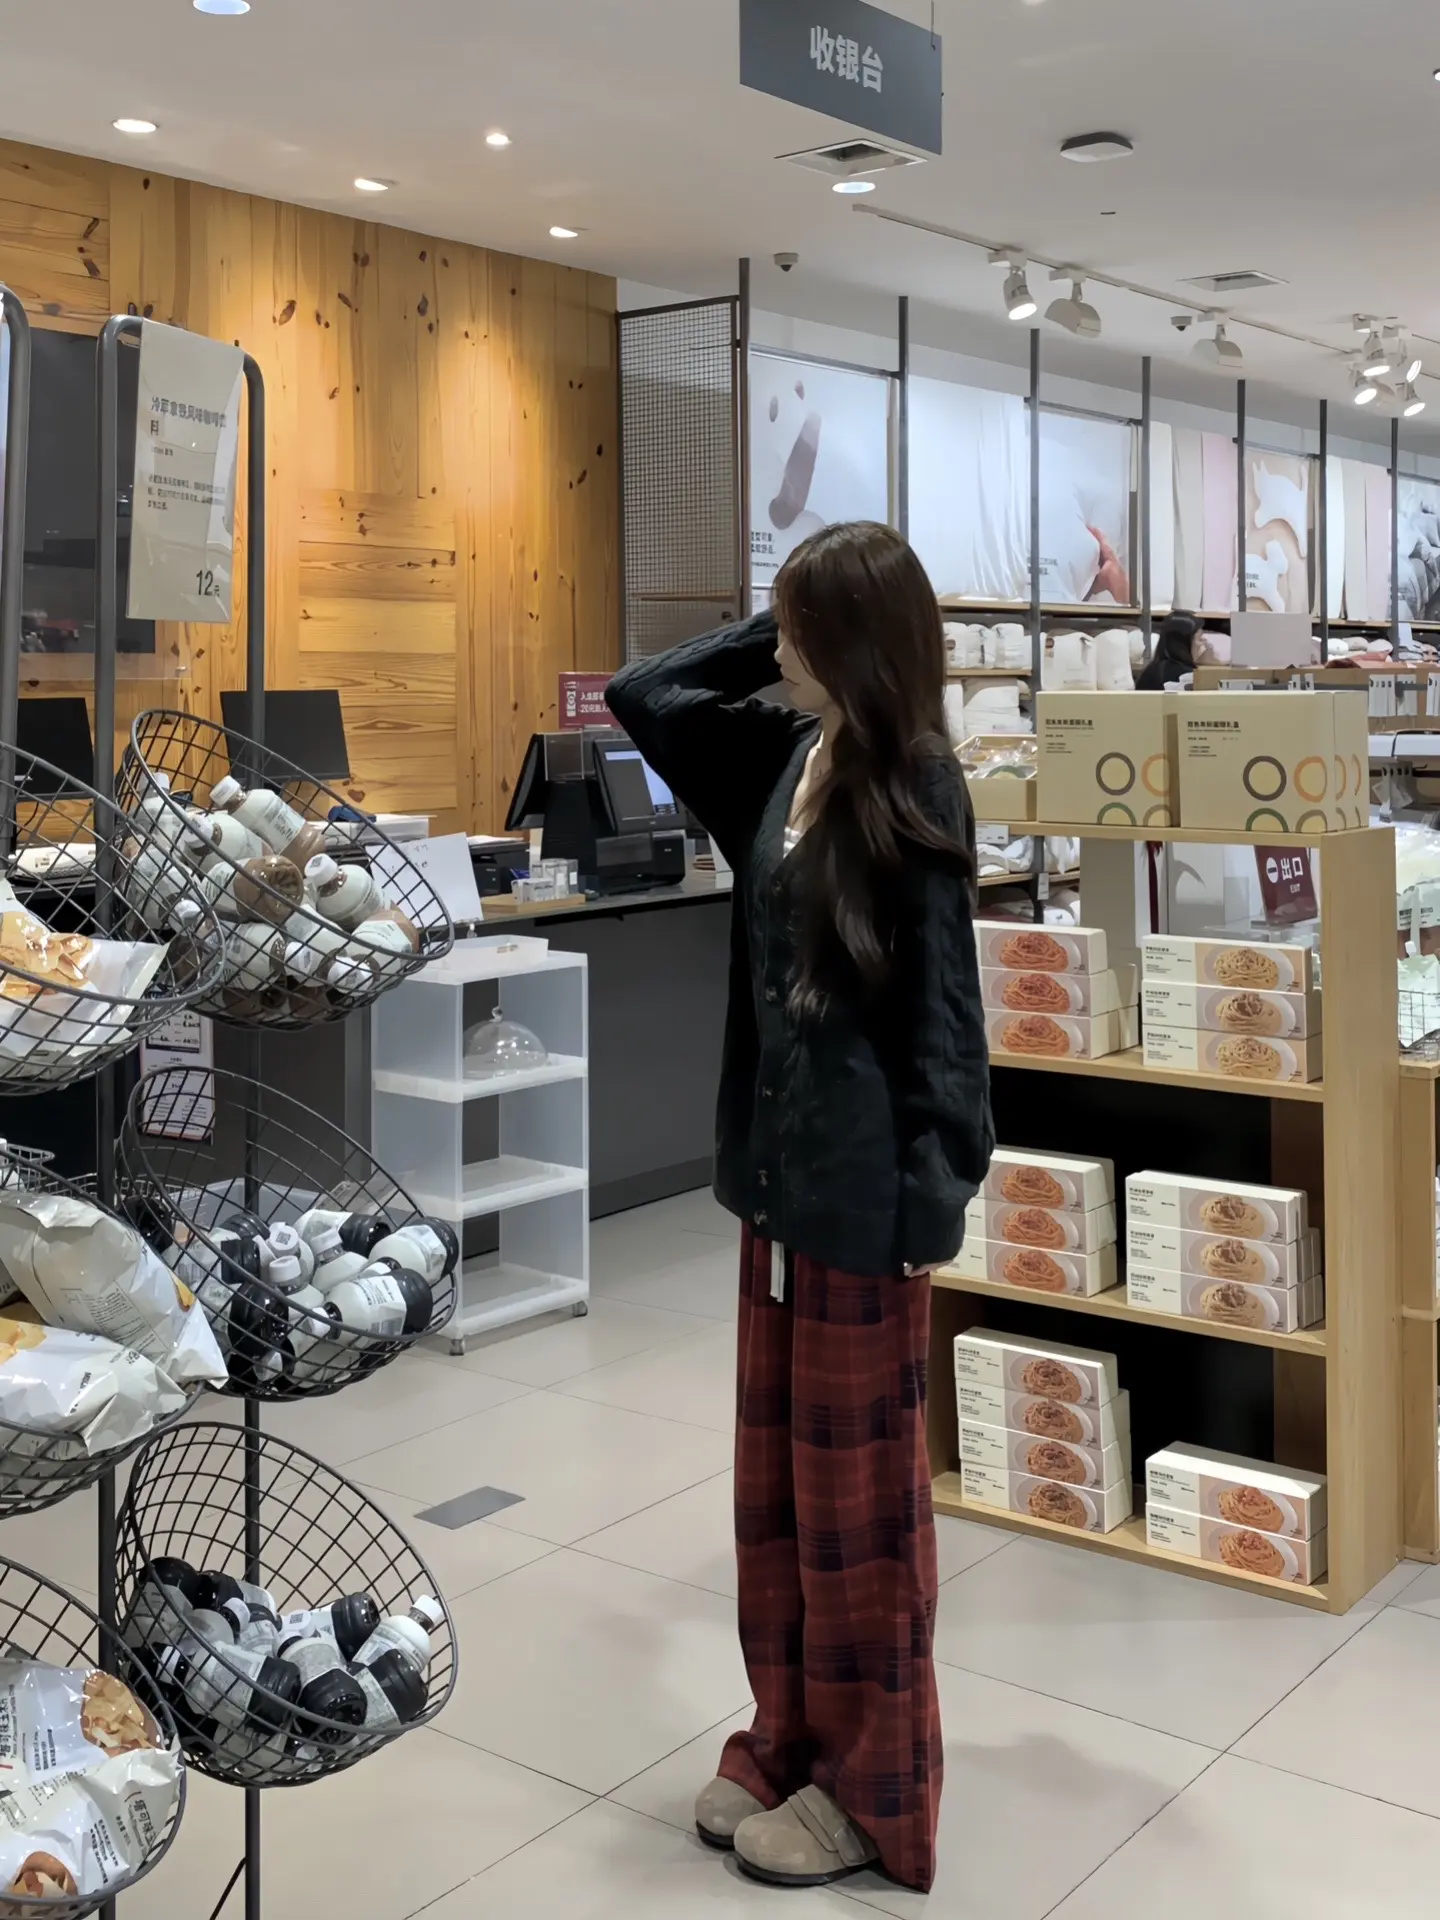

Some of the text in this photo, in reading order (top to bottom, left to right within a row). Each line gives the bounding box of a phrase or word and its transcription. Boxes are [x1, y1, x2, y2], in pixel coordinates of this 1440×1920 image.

[809, 25, 884, 93] 收银台
[1281, 857, 1303, 880] 出口
